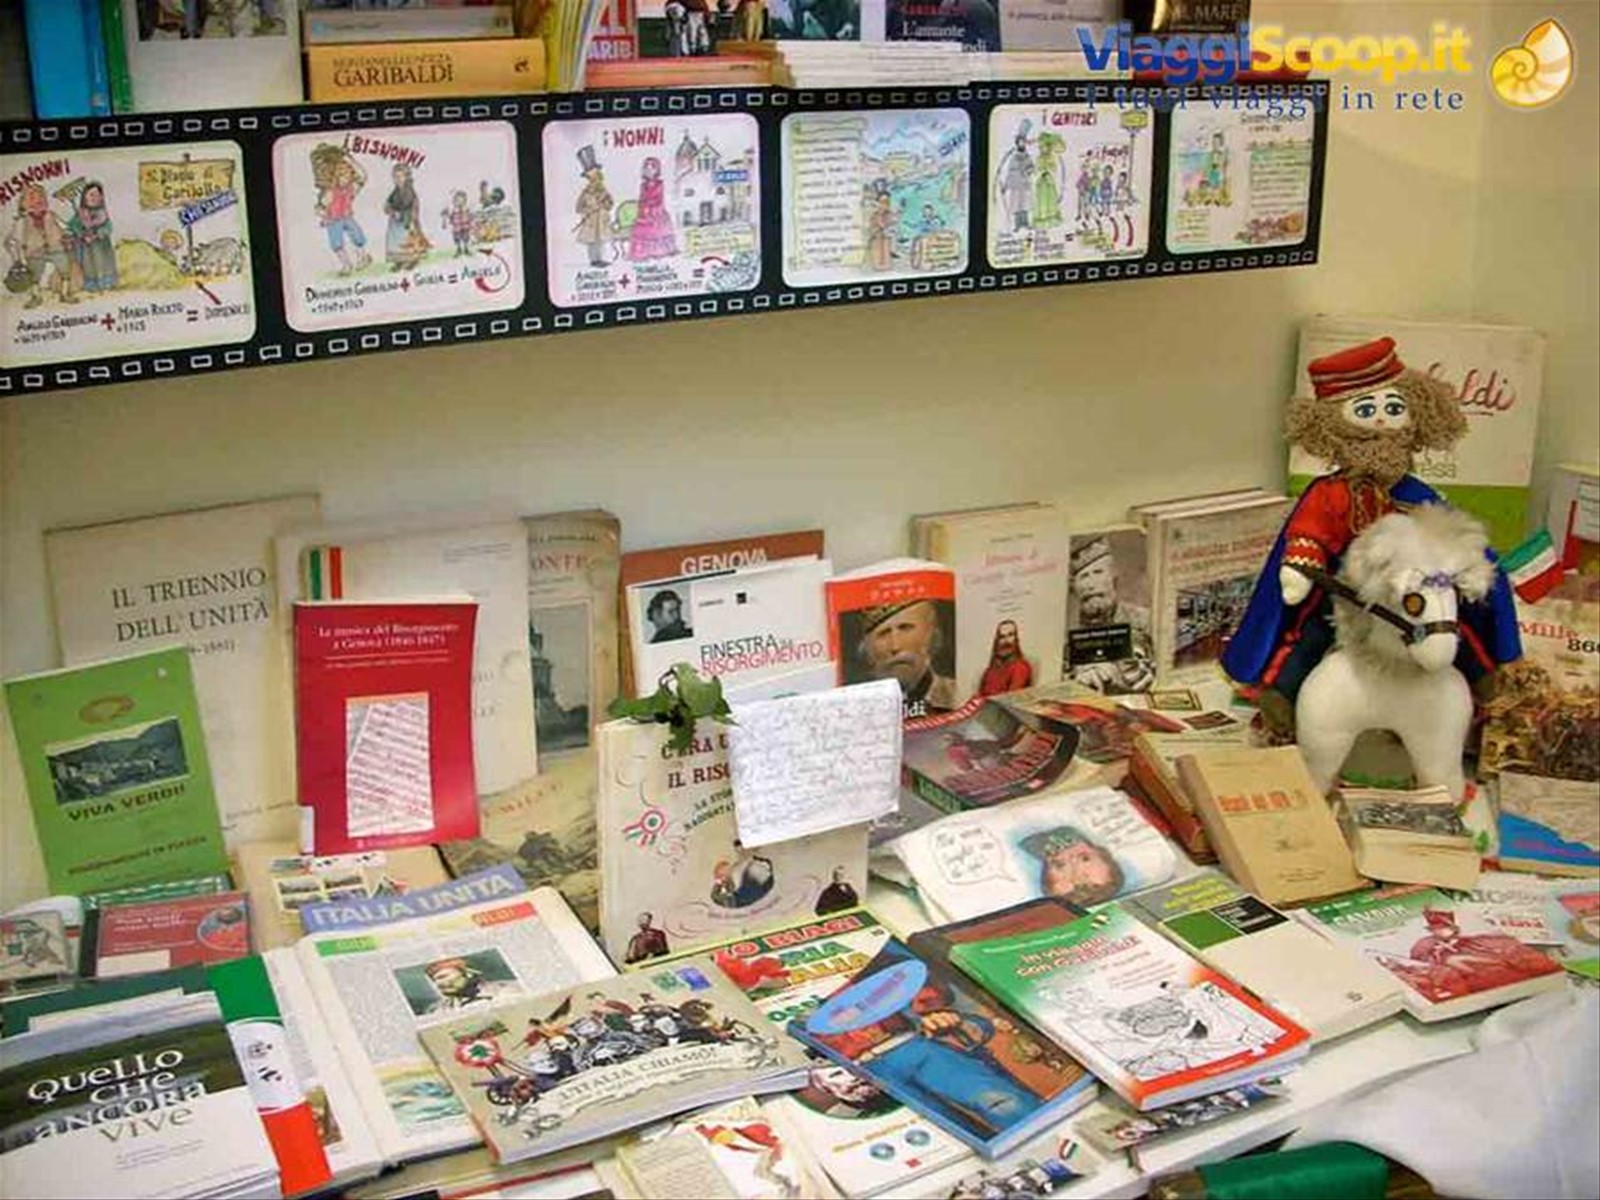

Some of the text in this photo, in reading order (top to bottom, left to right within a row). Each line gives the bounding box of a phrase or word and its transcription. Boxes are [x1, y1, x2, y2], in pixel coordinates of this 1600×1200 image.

[588, 39, 633, 60] ARIB
[333, 64, 454, 88] GARIBALDI
[681, 547, 768, 576] GENOVA
[111, 567, 267, 609] IL TRIENNIO
[700, 633, 778, 662] FINESTRA
[701, 641, 824, 676] RISORGIMENTO
[661, 738, 714, 760] CRA
[668, 771, 686, 789] IL
[69, 802, 115, 822] VIVA
[312, 902, 412, 927] ITALIA
